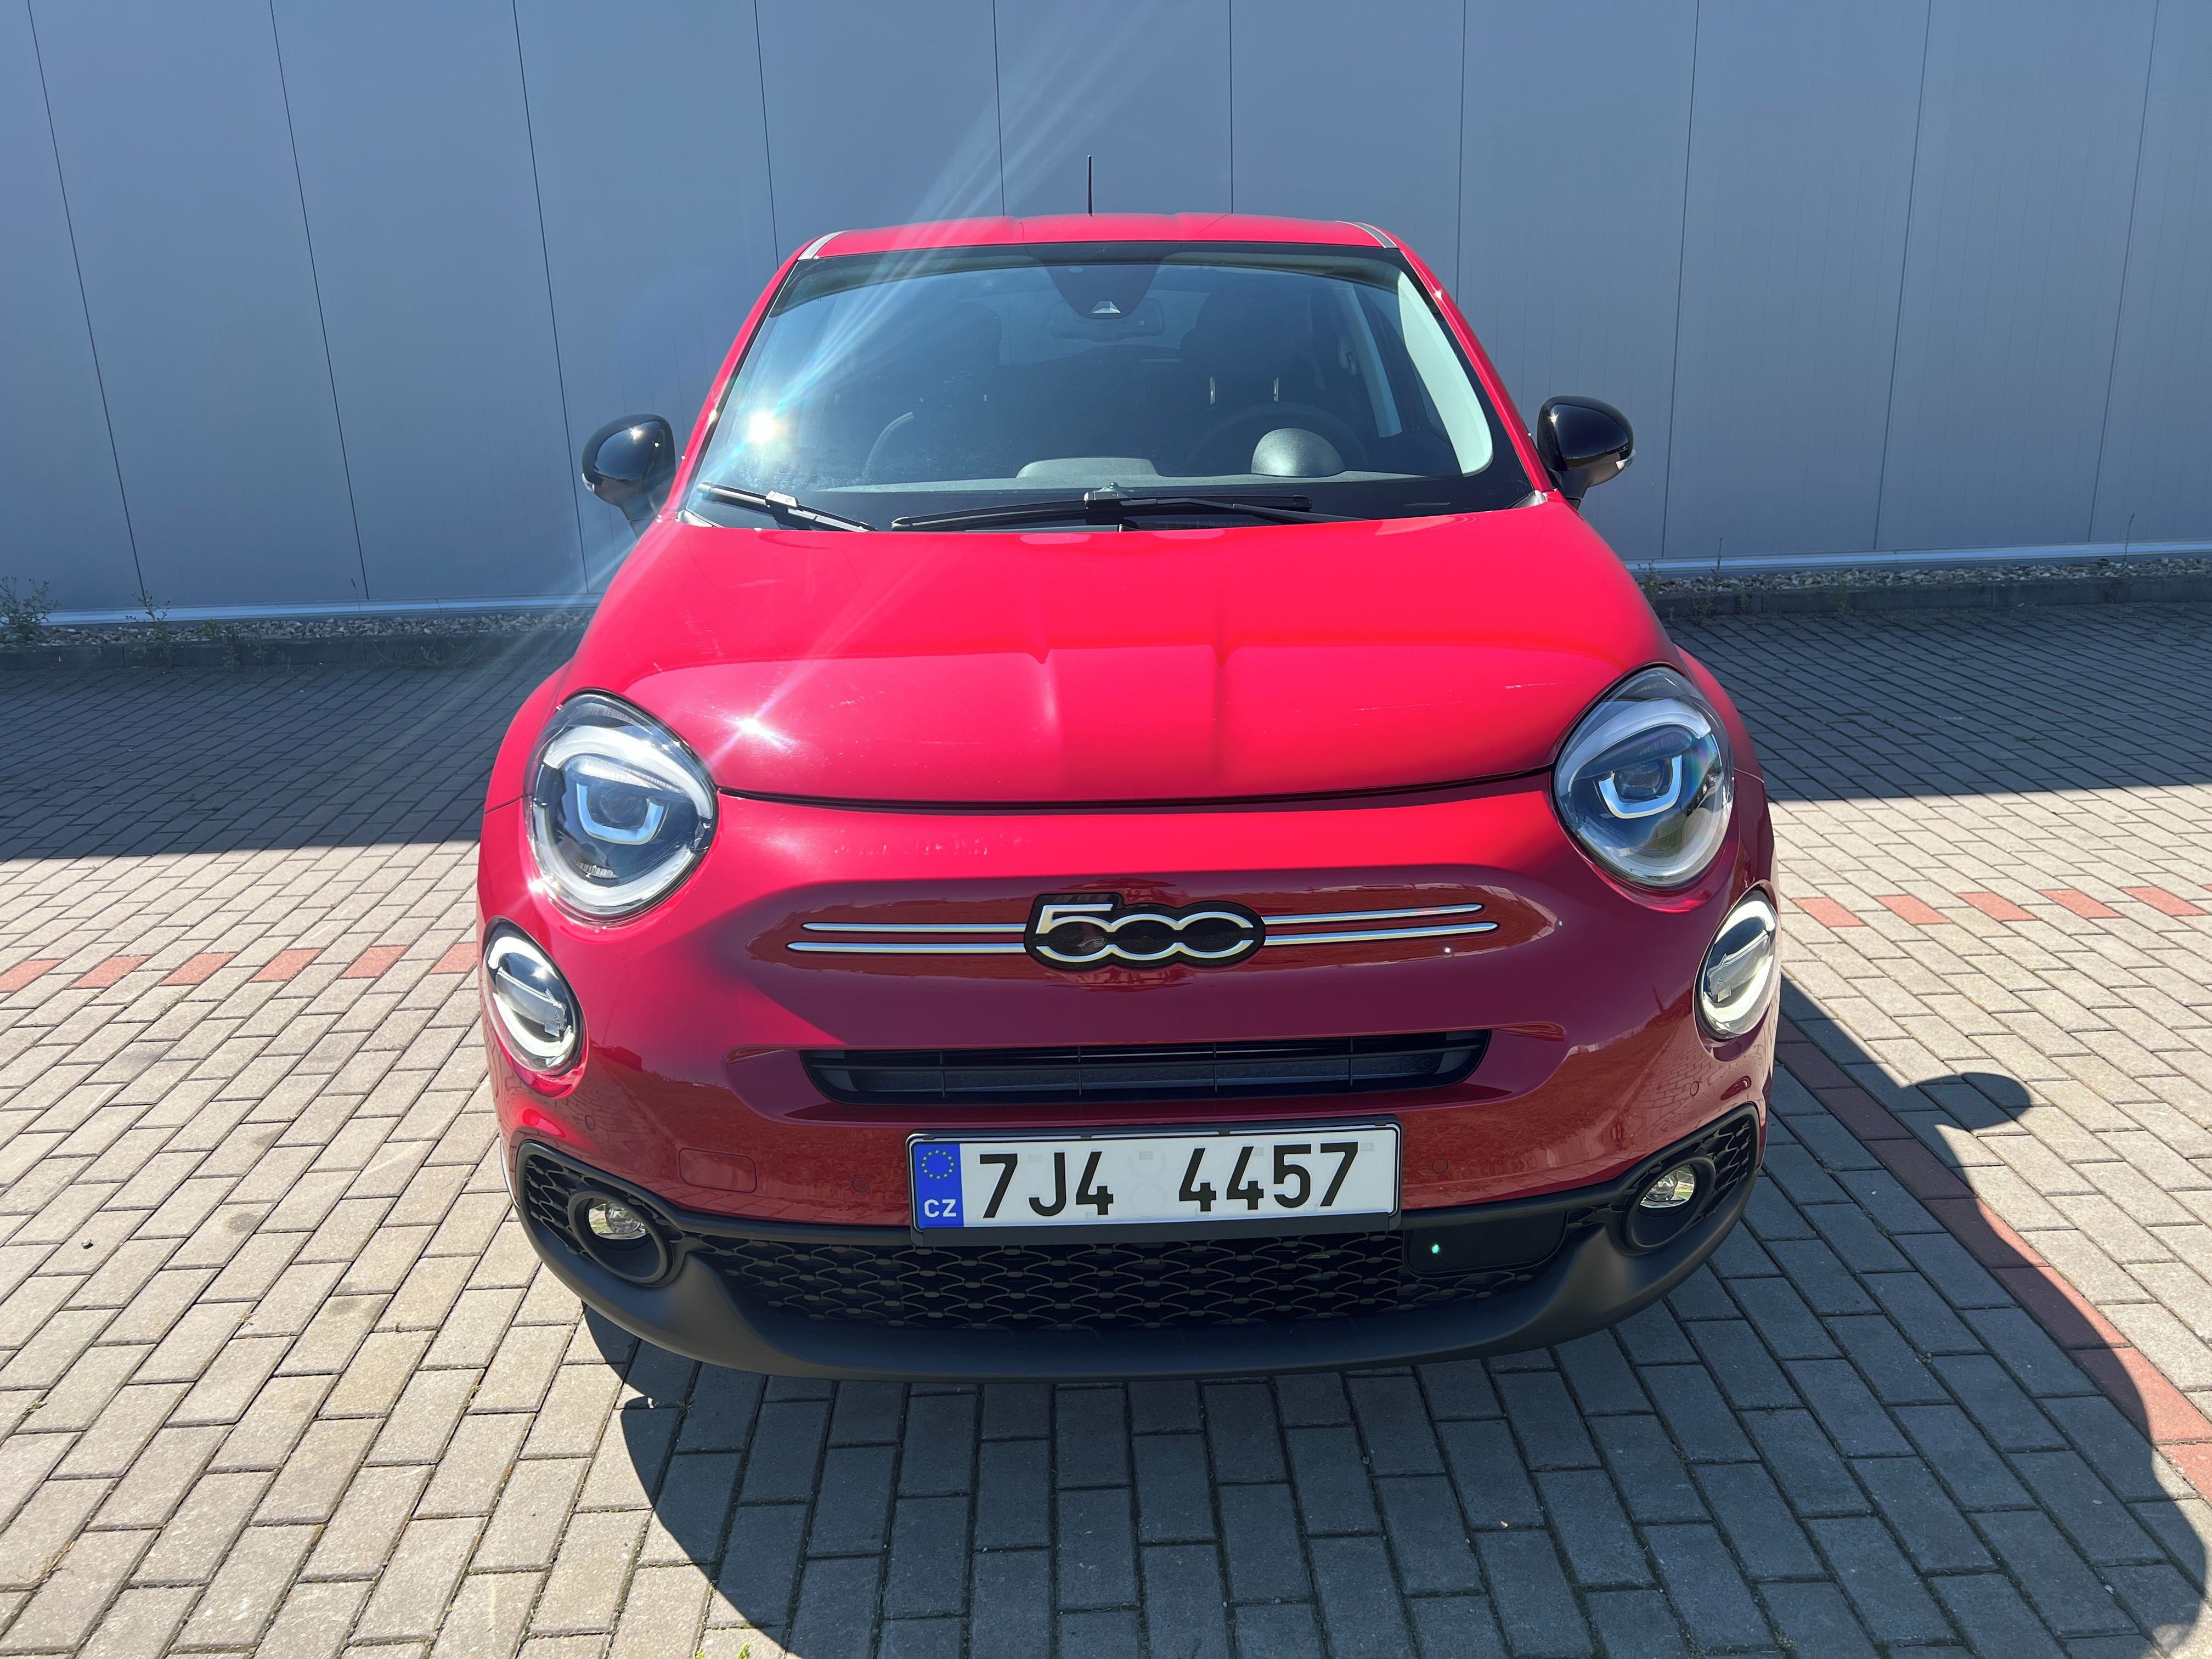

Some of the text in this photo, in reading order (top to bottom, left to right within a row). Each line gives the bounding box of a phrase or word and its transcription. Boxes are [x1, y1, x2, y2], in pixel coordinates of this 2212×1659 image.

[1036, 904, 1254, 962] 500
[924, 1199, 957, 1217] CZ
[979, 1141, 1358, 1218] 7J4 4457
